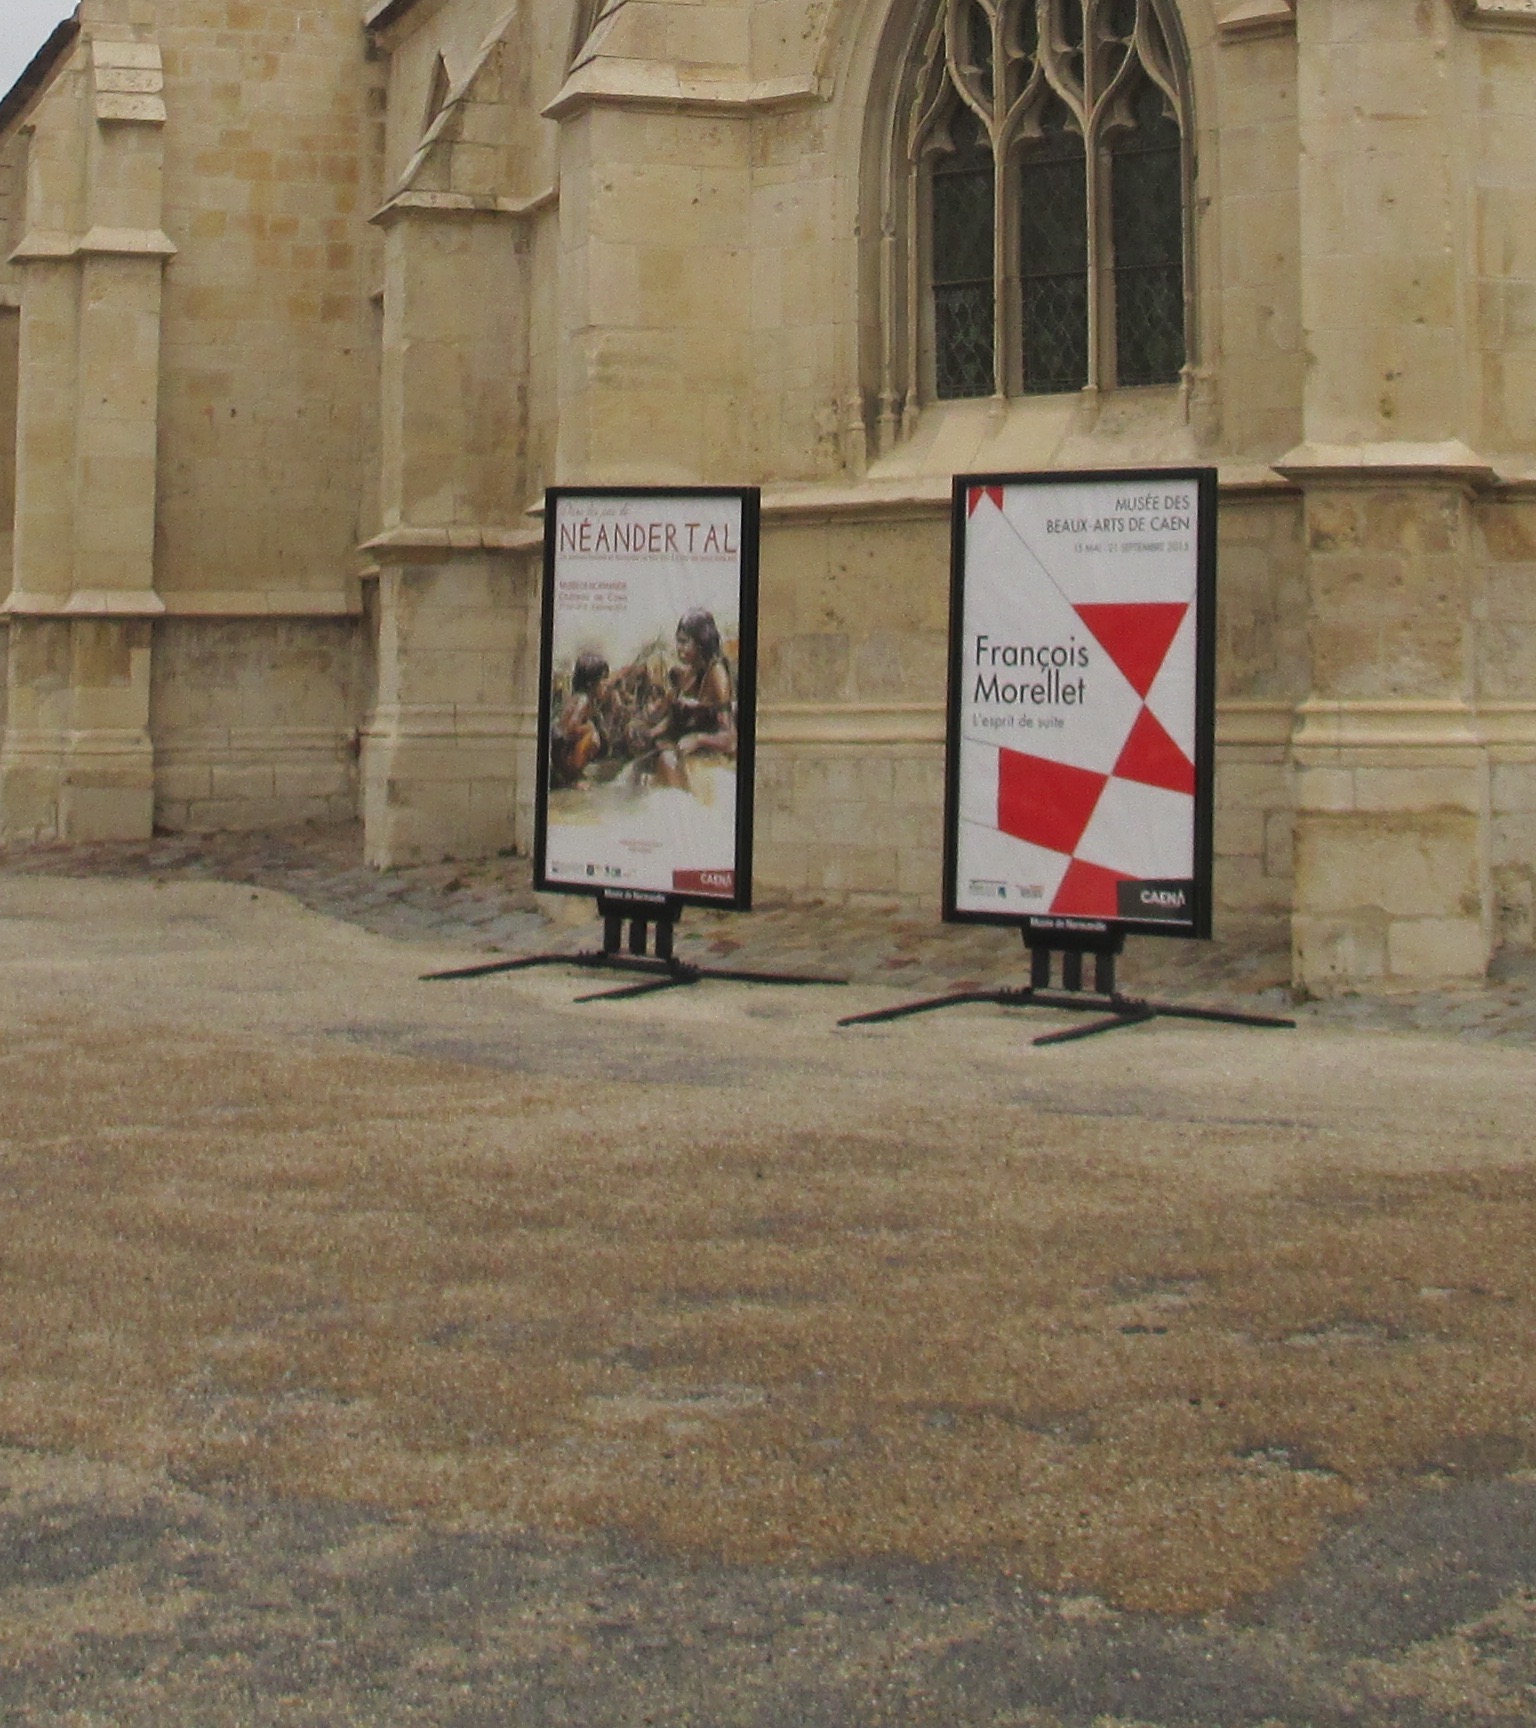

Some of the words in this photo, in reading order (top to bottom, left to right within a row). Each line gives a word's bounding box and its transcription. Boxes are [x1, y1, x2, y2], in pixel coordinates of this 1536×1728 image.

[1115, 494, 1160, 512] MUSÉE
[1165, 495, 1190, 511] DES
[560, 517, 737, 554] NÉANDERTAL
[1129, 517, 1145, 532] DE
[1150, 516, 1190, 531] CAEN
[976, 635, 1090, 673] François
[973, 668, 1086, 705] Morellet
[973, 714, 1015, 729] L'esprit
[1018, 713, 1034, 728] de
[1038, 715, 1065, 729] suite
